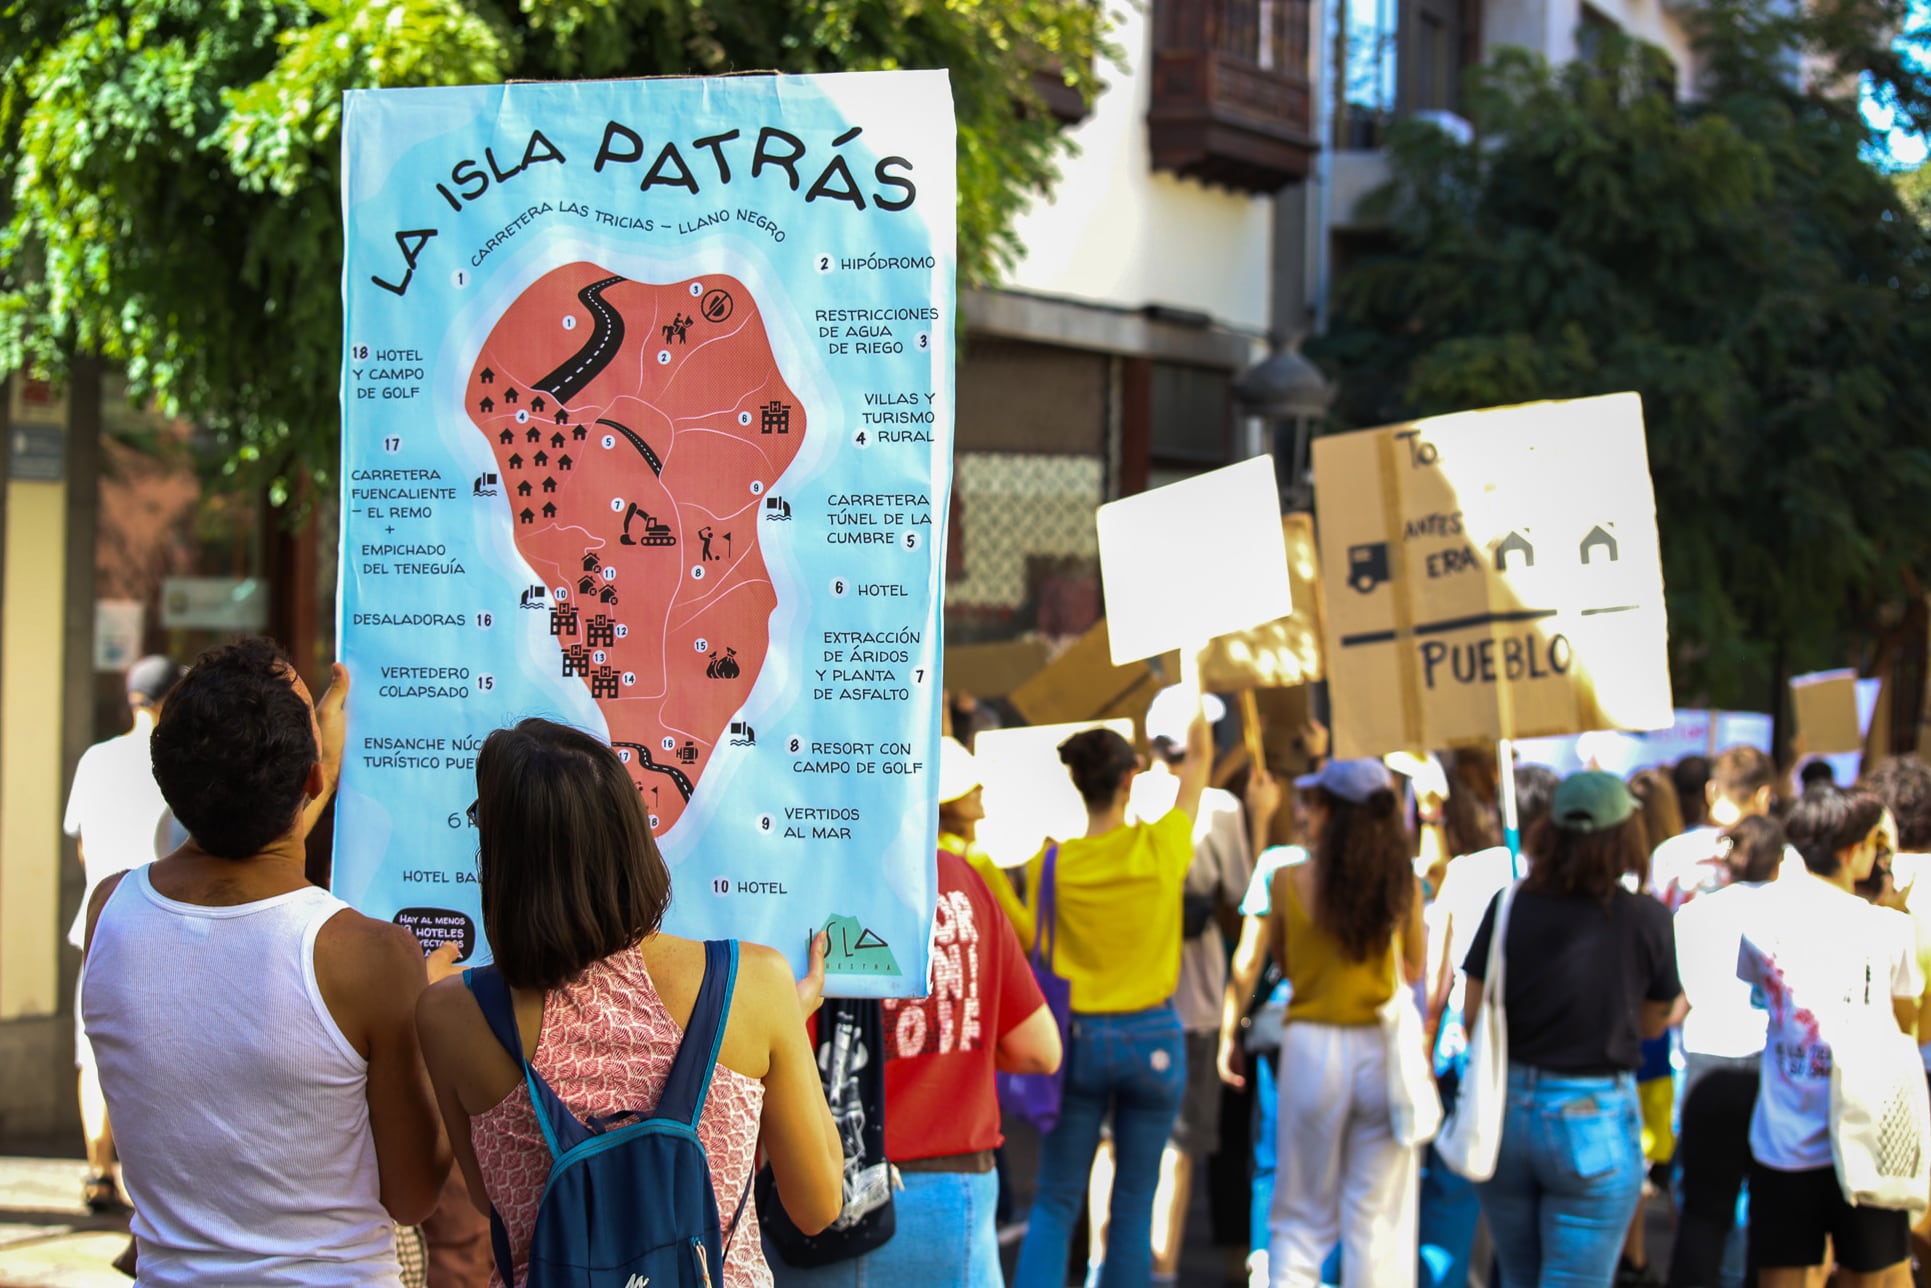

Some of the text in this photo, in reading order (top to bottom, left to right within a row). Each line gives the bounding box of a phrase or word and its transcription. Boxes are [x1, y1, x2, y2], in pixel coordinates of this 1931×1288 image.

[370, 120, 917, 297] LA ISLA PATRÁS
[471, 201, 554, 267] CARRETERA
[559, 200, 589, 218] LAS
[595, 209, 654, 232] TRICIAS
[678, 209, 730, 235] LLANO
[736, 208, 786, 243] NEGRO
[820, 251, 936, 271] 2 HIPÓDROMO
[457, 272, 463, 285] 1
[692, 285, 700, 295] 3
[815, 307, 939, 322] RESTRICCIONES
[566, 318, 571, 328] 1
[819, 325, 893, 338] DE AGUA
[829, 341, 904, 355] DE RIEGO
[919, 334, 928, 348] 3
[352, 345, 423, 362] 18 HOTEL
[661, 352, 667, 363] 2
[352, 367, 425, 381] Y CAMPO
[357, 386, 420, 400] DE GOLF
[864, 392, 936, 406] VILLAS Y
[519, 412, 525, 421] 4
[741, 414, 748, 424] 6
[861, 410, 935, 424] TURISMO
[385, 437, 400, 452] 17
[605, 437, 612, 447] 5
[855, 430, 935, 446] 4 RURAL
[351, 469, 442, 481] CARRETERA
[351, 487, 457, 500] FUENCALIENTE
[753, 483, 760, 493] 9
[615, 500, 621, 510] 7
[827, 494, 930, 507] CARRETERA
[367, 507, 385, 519] EL
[389, 506, 432, 519] REMO
[826, 507, 933, 526] TÚNEL DE LA
[1403, 512, 1463, 542] ANTES
[826, 531, 915, 549] CUMBRE 5
[361, 544, 446, 556] EMPICHADO
[363, 557, 466, 575] DEL TENEGUÍA
[1425, 544, 1481, 580] ERA
[604, 569, 614, 579] 11
[695, 568, 702, 578] 8
[555, 589, 567, 599] 10
[835, 580, 909, 597] 6 HOTEL
[353, 613, 492, 627] DESALADORAS 16
[616, 626, 627, 636] 12
[823, 625, 921, 644] EXTRACCIÓN
[695, 641, 706, 651] 15
[594, 653, 605, 663] 13
[823, 644, 909, 663] DE ÁRIDOS
[1419, 633, 1573, 690] PUEBLO
[380, 666, 470, 680] VERTEDERO
[624, 674, 635, 684] 14
[815, 669, 896, 682] Y PLANTA
[915, 669, 925, 684] 7
[478, 676, 493, 690] 15
[378, 685, 469, 699] COLAPSADO
[813, 687, 909, 701] DE ASFALTO
[364, 734, 481, 751] ENSANCHE NÚC
[663, 739, 674, 749] 16
[789, 738, 911, 756] 8 RESORT CON
[363, 751, 476, 770] TURÍSTICO PUE
[792, 761, 923, 775] CAMPO DE GOLF
[447, 812, 462, 829] 6
[784, 807, 860, 821] VERTIDOS
[761, 816, 770, 831] 9
[783, 826, 852, 840] AL MAR
[402, 870, 450, 884] HOTEL
[713, 879, 788, 895] 10 HOTEL
[420, 916, 433, 925] AL
[435, 916, 466, 926] MENOS
[415, 927, 465, 939] HOTELES
[824, 961, 892, 972] UESTRA
